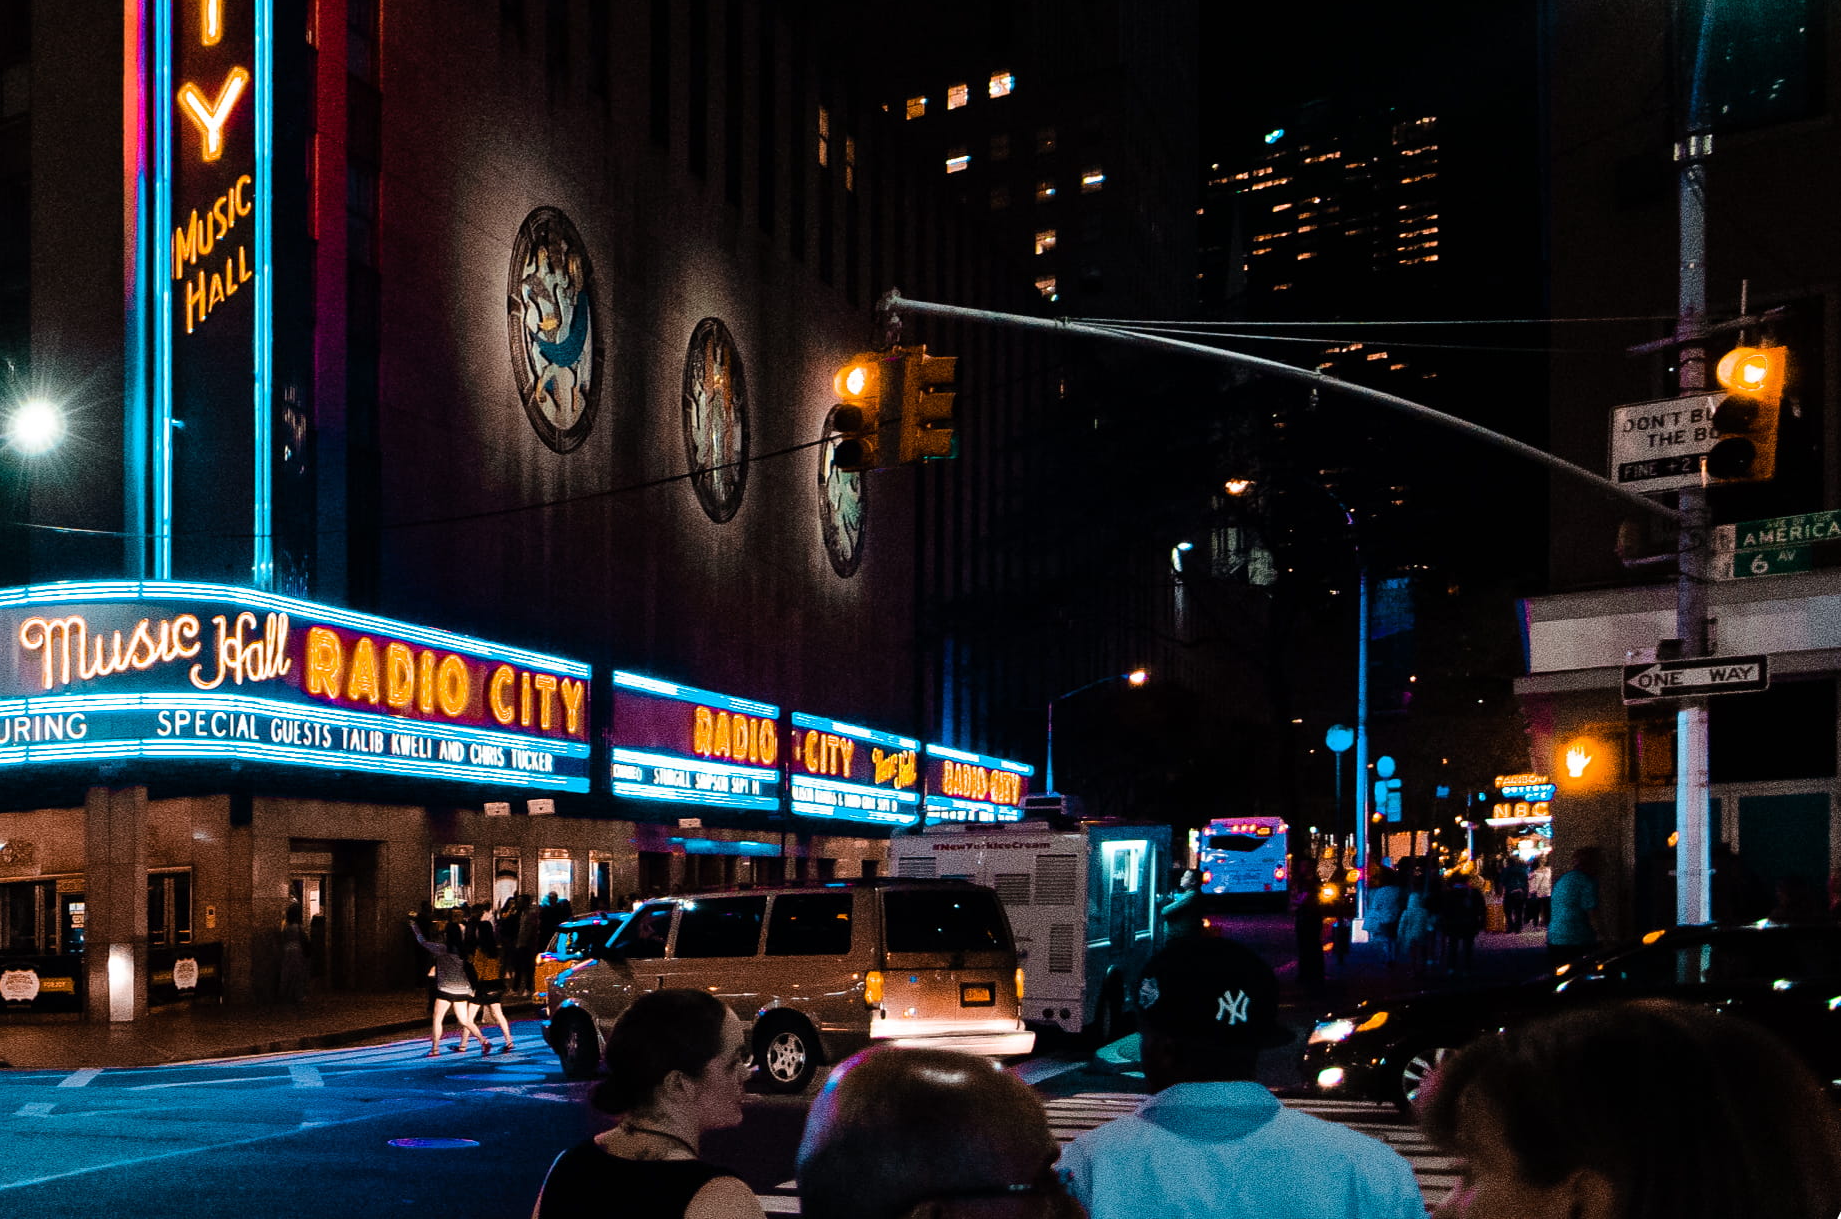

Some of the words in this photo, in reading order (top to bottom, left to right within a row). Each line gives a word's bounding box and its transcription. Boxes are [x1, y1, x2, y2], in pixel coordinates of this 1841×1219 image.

[175, 174, 252, 280] MUSIC
[186, 245, 253, 334] HALL
[1623, 411, 1683, 433] DON'T
[1647, 429, 1686, 448] THE
[1694, 427, 1719, 442] BO
[1624, 463, 1659, 479] FINE
[1750, 554, 1769, 574] 6
[1776, 549, 1797, 561] AV
[20, 612, 201, 690] Music
[189, 611, 292, 690] Hall
[306, 626, 471, 718] RADIO
[489, 664, 584, 734] CITY
[1638, 671, 1684, 689] ONE
[1709, 665, 1754, 682] WAY
[157, 710, 260, 740] SPECIAL
[270, 718, 333, 749] GUESTS
[341, 727, 384, 754] TALIB
[390, 733, 432, 759] KWELI
[438, 739, 465, 763] AND
[469, 743, 505, 768] CHRIS
[511, 748, 553, 773] TUCKER
[693, 705, 777, 766] RADIO
[804, 729, 856, 779] CITY
[942, 760, 987, 801] RADIO
[989, 769, 1021, 806] CITY
[1493, 802, 1549, 818] NBC
